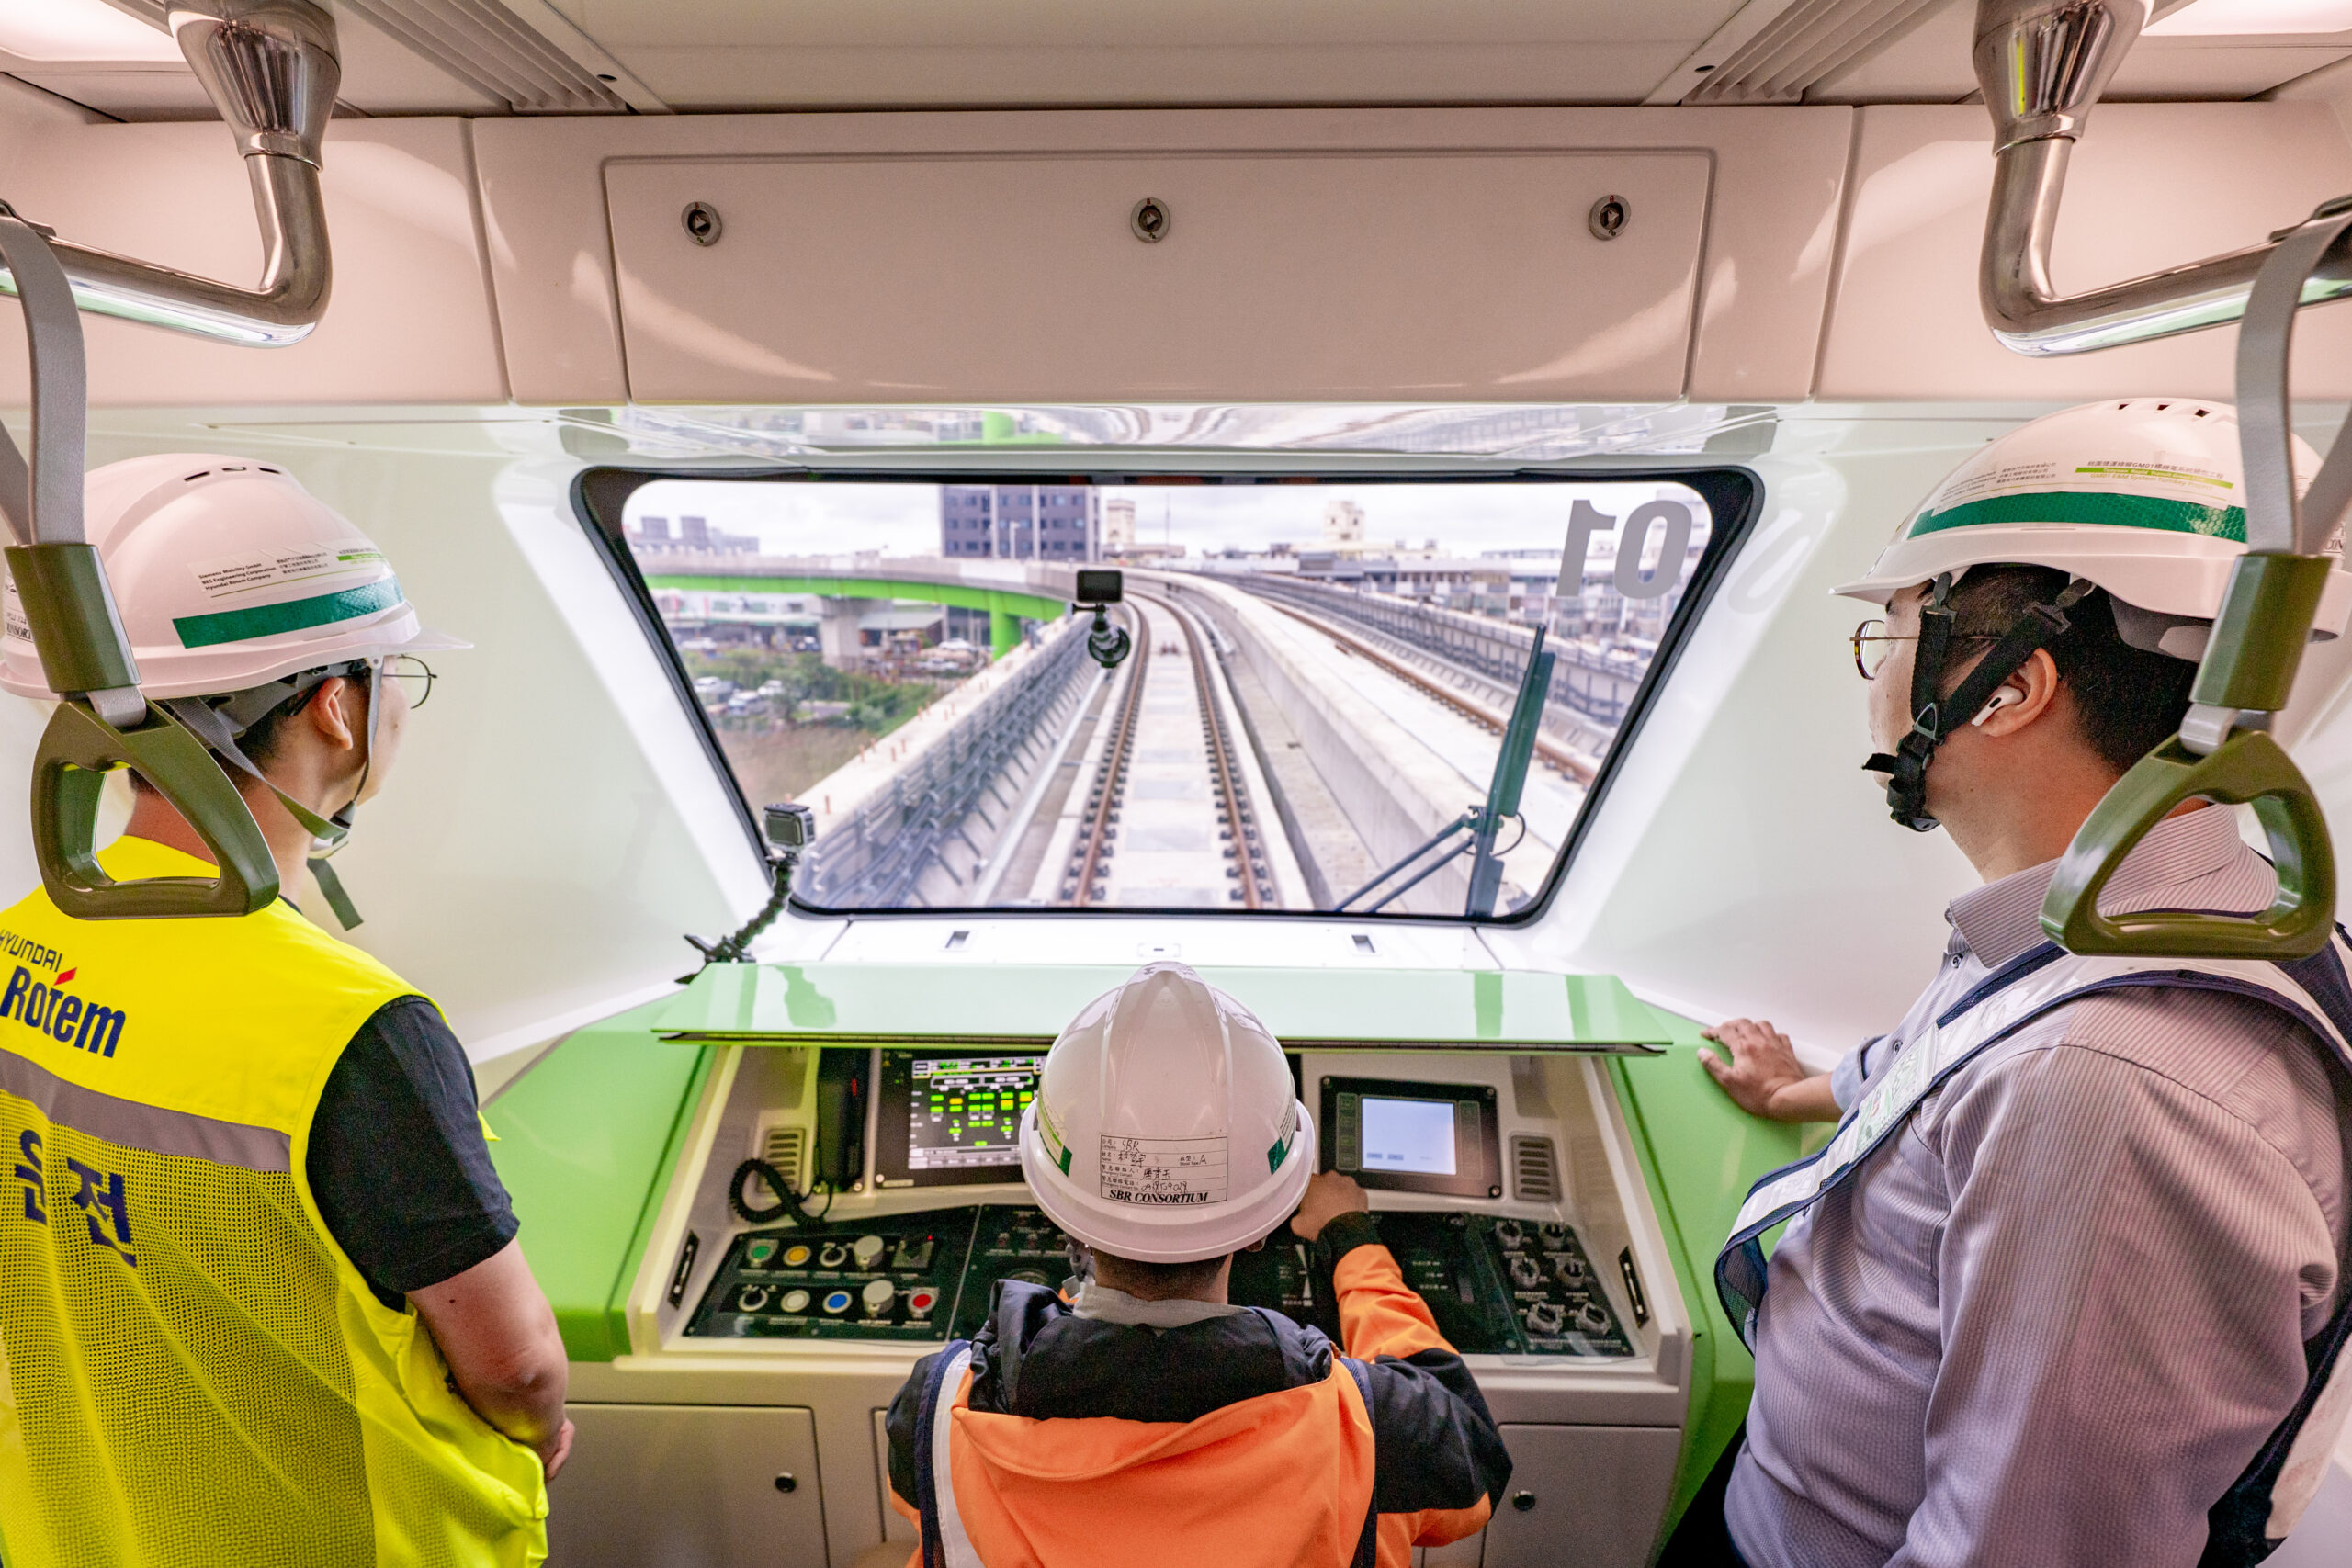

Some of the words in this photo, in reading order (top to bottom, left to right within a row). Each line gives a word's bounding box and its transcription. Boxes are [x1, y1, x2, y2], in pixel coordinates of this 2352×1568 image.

[0, 929, 62, 972] HYUNDAI
[0, 965, 126, 1058] Rotem
[1199, 1154, 1207, 1165] A
[1109, 1189, 1133, 1201] SBR
[1135, 1191, 1209, 1203] CONSORTIUM
